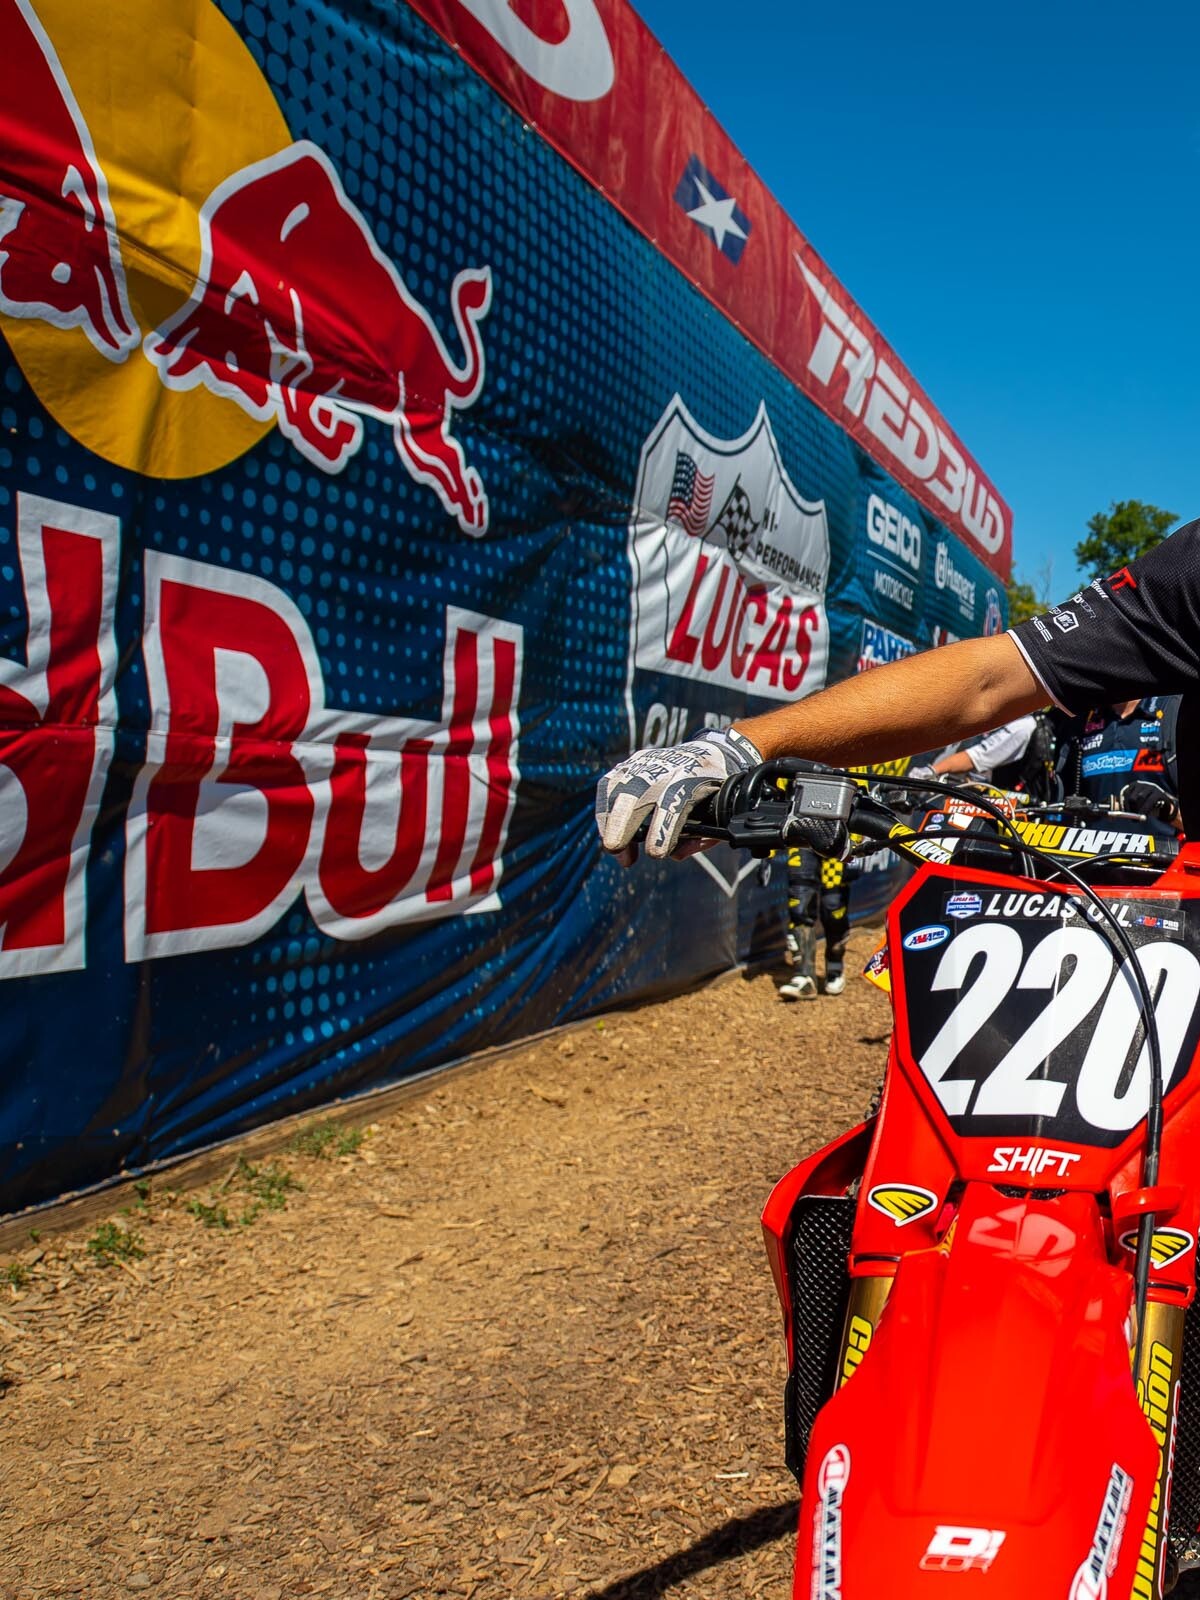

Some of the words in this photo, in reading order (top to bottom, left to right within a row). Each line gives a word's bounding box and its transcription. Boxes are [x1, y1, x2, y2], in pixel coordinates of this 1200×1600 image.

[867, 494, 921, 571] GEICO
[756, 540, 821, 592] PERFORMANCE
[666, 554, 819, 693] LUCAS
[124, 548, 523, 963] Bull
[655, 784, 689, 847] VENT
[985, 893, 1082, 919] LUCAS
[987, 1147, 1081, 1177] SHIFT
